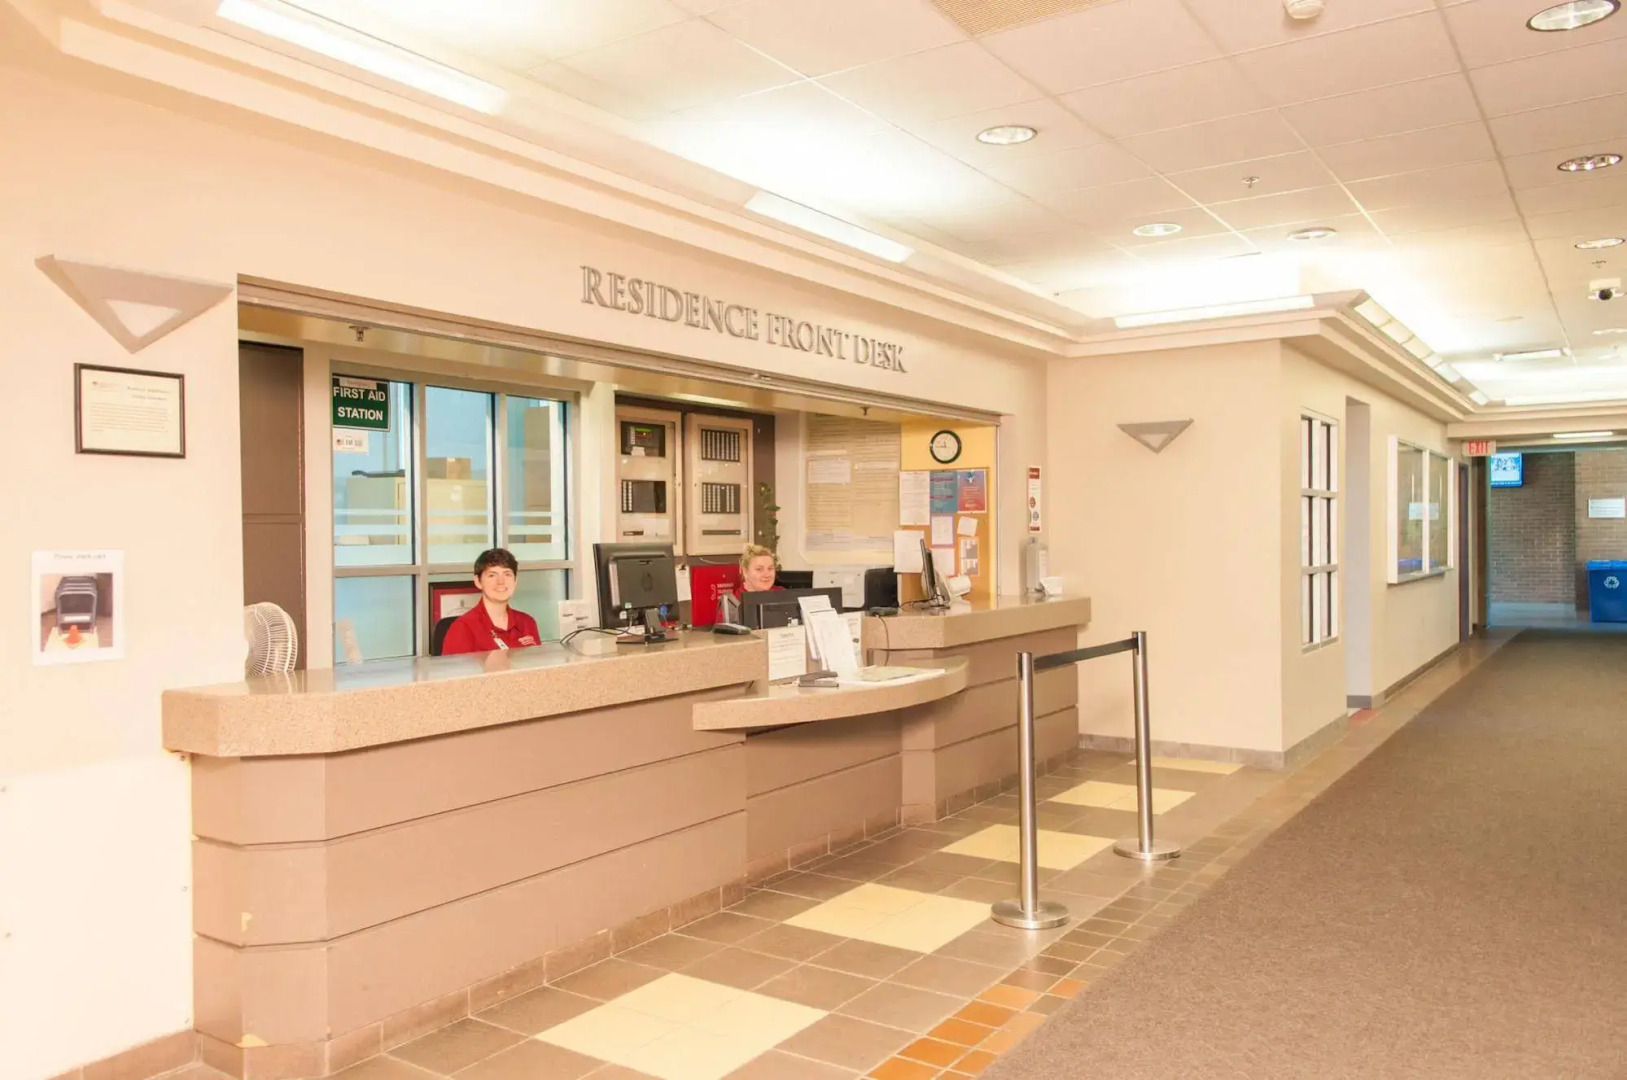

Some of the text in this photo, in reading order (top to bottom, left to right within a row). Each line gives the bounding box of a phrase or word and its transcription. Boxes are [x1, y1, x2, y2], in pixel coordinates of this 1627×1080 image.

[580, 265, 908, 373] RESIDENCE FRONT DESK
[333, 387, 386, 402] FIRST AID
[337, 406, 383, 420] STATION
[1468, 440, 1489, 455] EXIT
